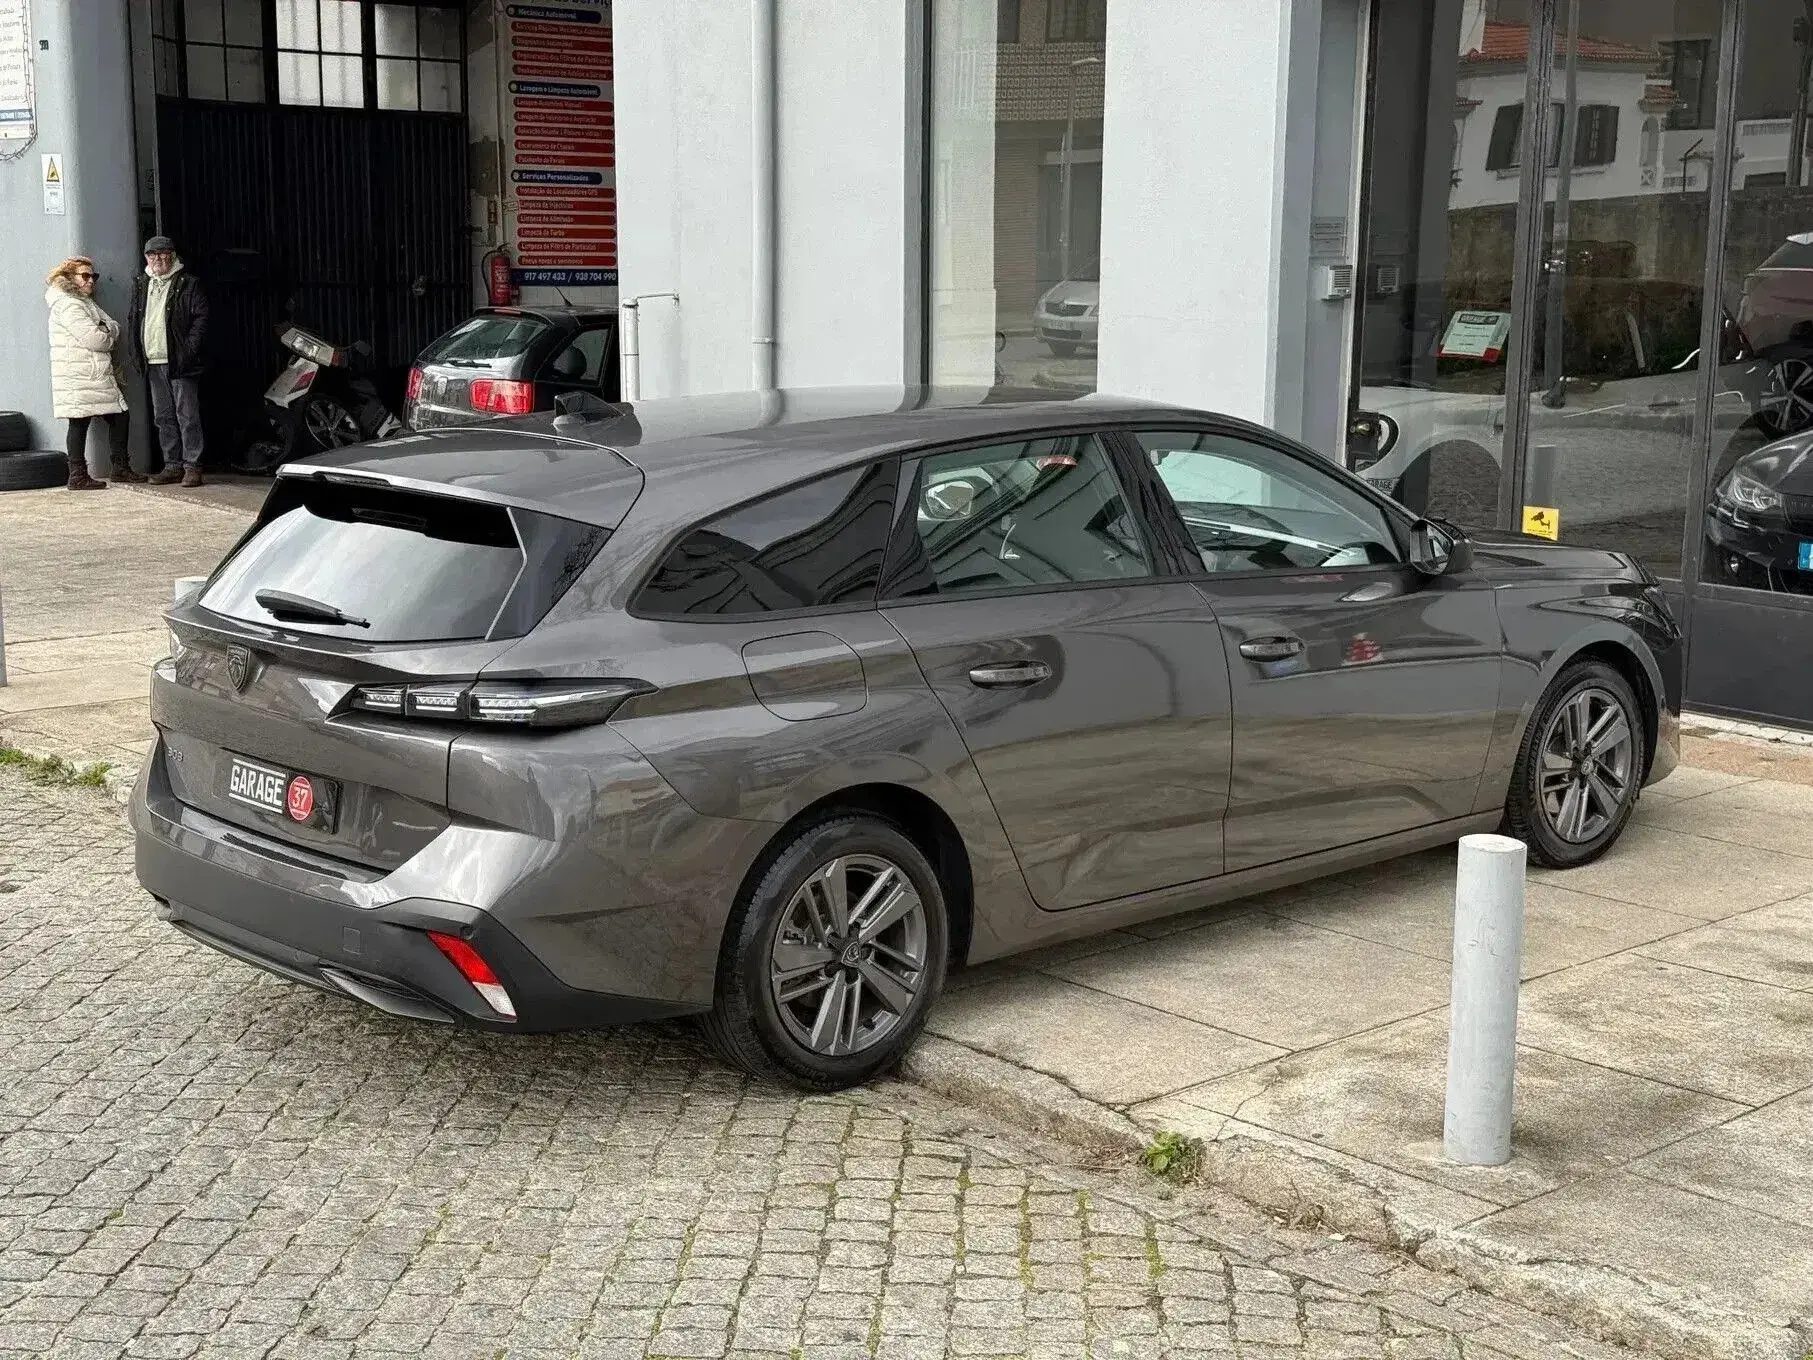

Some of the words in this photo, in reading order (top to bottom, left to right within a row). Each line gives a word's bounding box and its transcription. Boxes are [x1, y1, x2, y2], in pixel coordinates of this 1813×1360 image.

[522, 172, 546, 182] Serviços
[547, 173, 589, 182] Personalizados
[520, 215, 541, 223] Limpeza
[520, 228, 542, 236] Limpeza
[521, 243, 542, 251] Limpeza
[524, 272, 536, 281] 917
[537, 272, 551, 281] 497
[552, 272, 566, 281] 433
[575, 272, 588, 281] 938
[589, 272, 602, 281] 704
[603, 272, 616, 281] 990
[230, 764, 284, 806] GARAGE
[292, 786, 308, 810] 37
